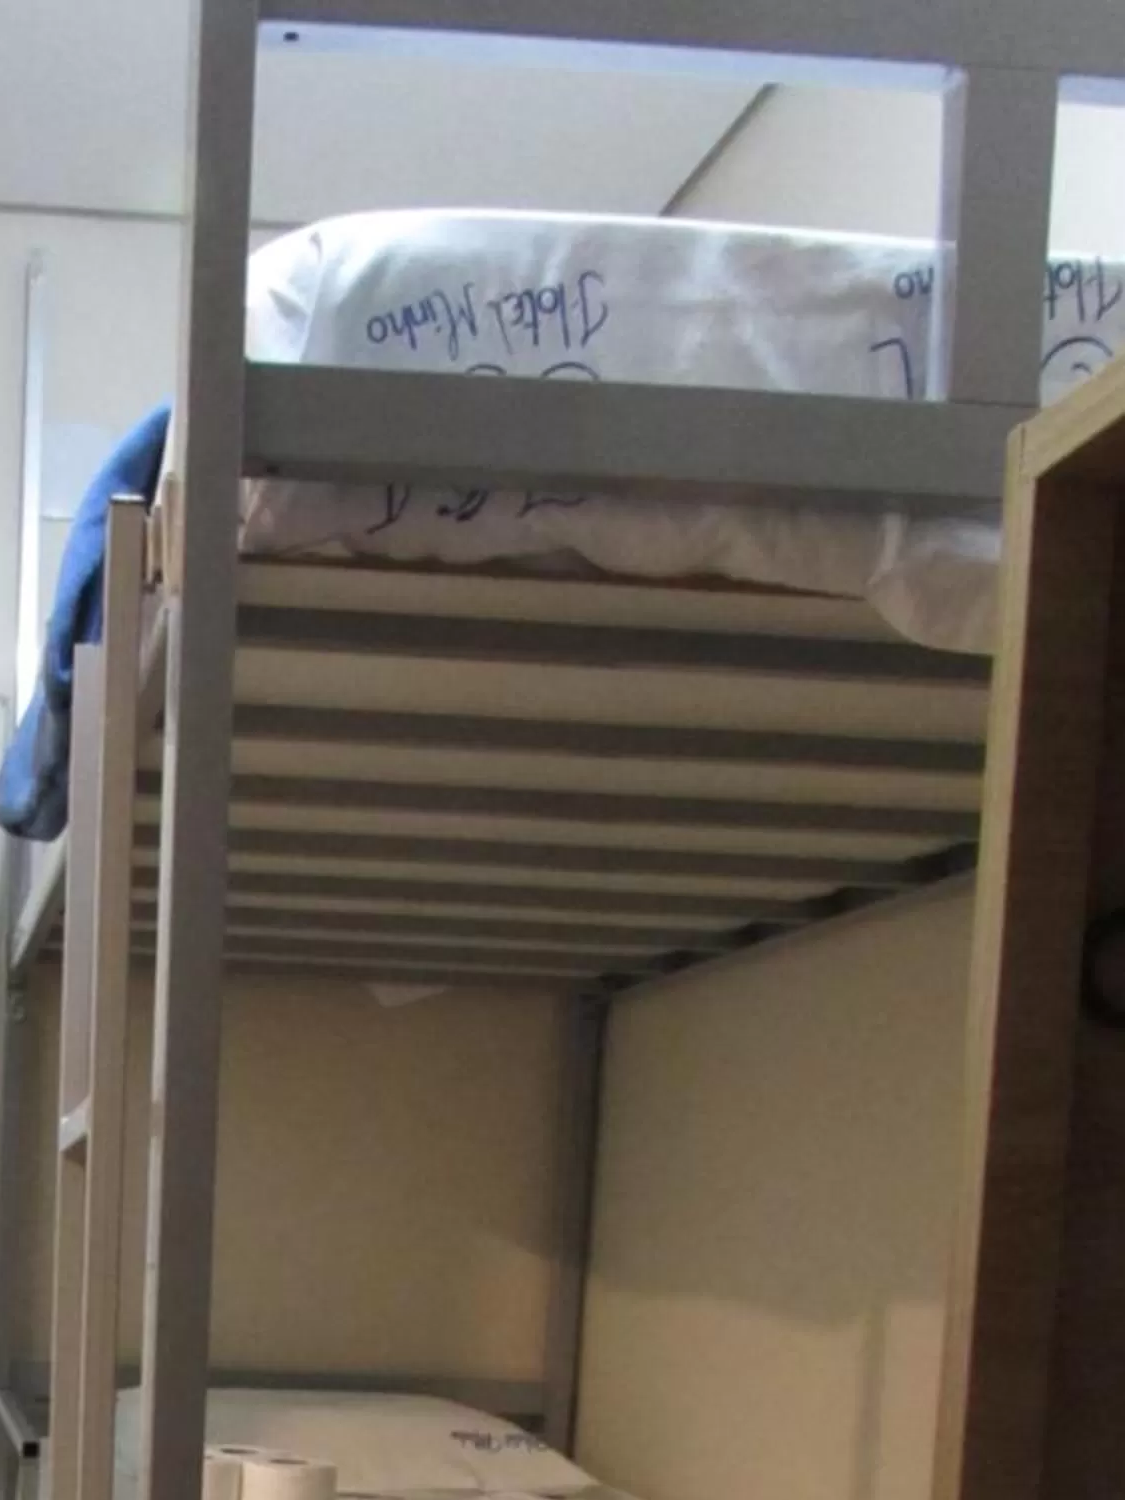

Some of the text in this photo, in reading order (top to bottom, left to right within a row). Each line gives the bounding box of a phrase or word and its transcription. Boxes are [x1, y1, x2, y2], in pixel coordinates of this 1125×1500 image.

[364, 270, 610, 362] Hotel Minho
[1044, 255, 1124, 322] Hot
